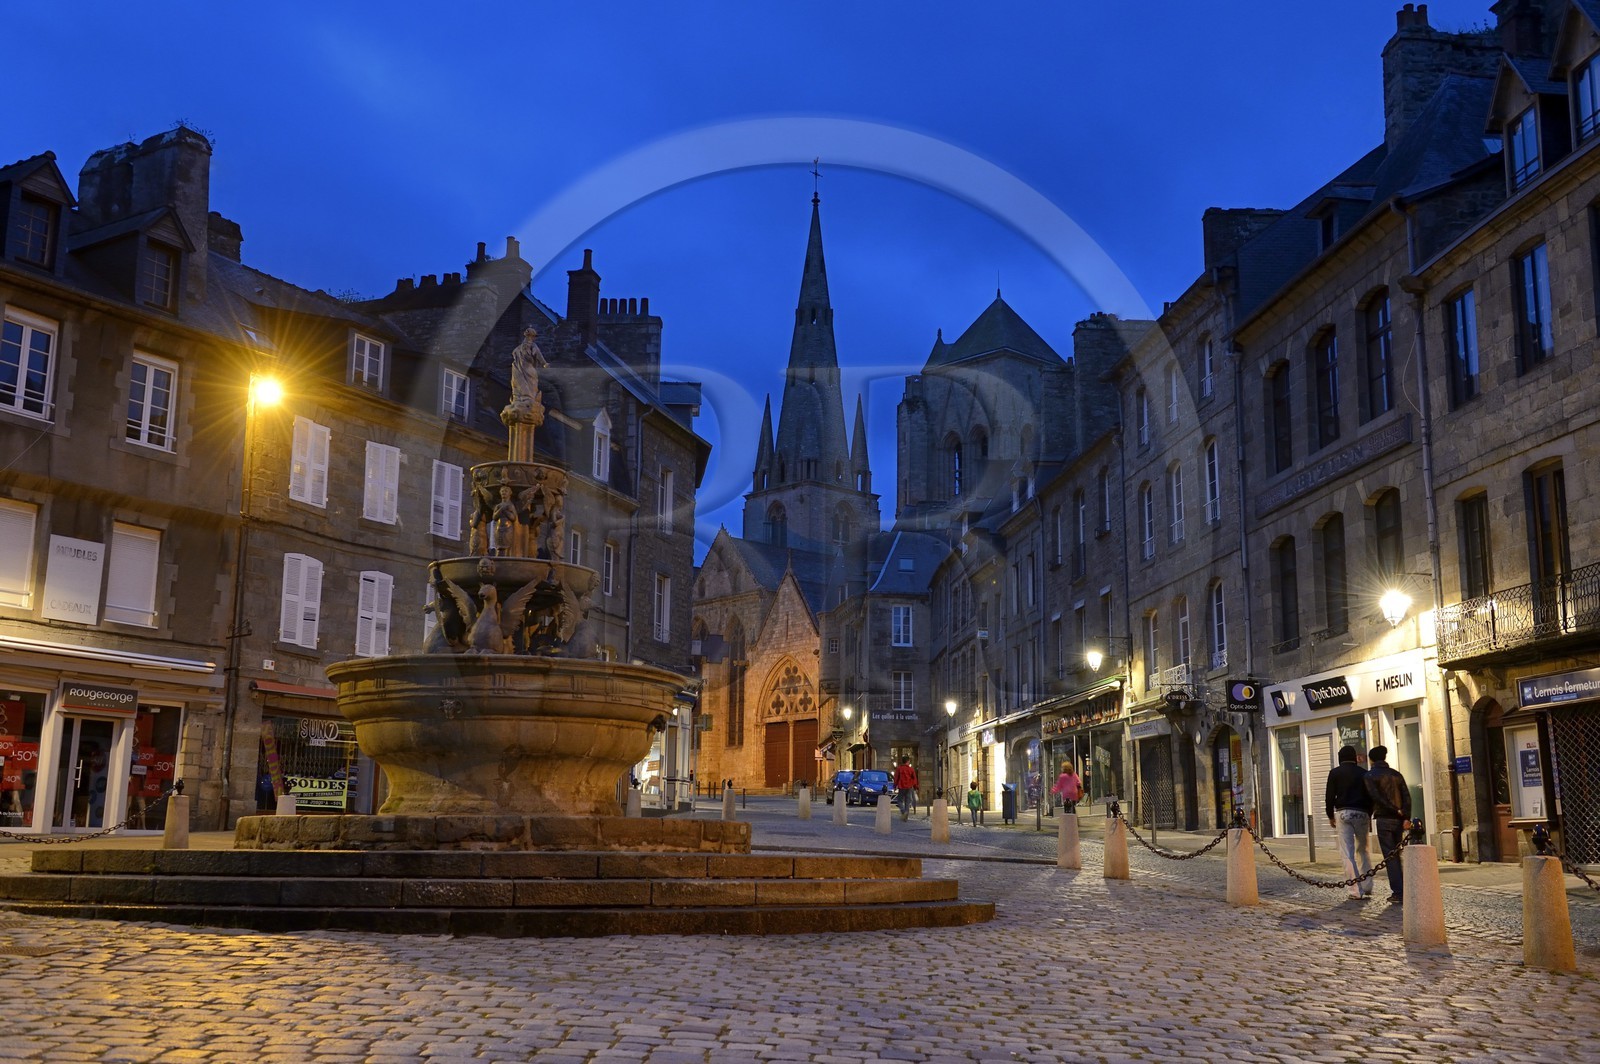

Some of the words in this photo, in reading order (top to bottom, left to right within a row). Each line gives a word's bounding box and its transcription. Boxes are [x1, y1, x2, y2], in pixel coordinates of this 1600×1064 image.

[56, 545, 98, 562] MEUBLES
[50, 599, 92, 615] CADEAUX
[1376, 679, 1382, 693] F.
[1382, 672, 1413, 692] MESLIN
[1229, 703, 1244, 711] Optic
[1244, 703, 1258, 711] 2000
[289, 778, 346, 790] SOLDES
